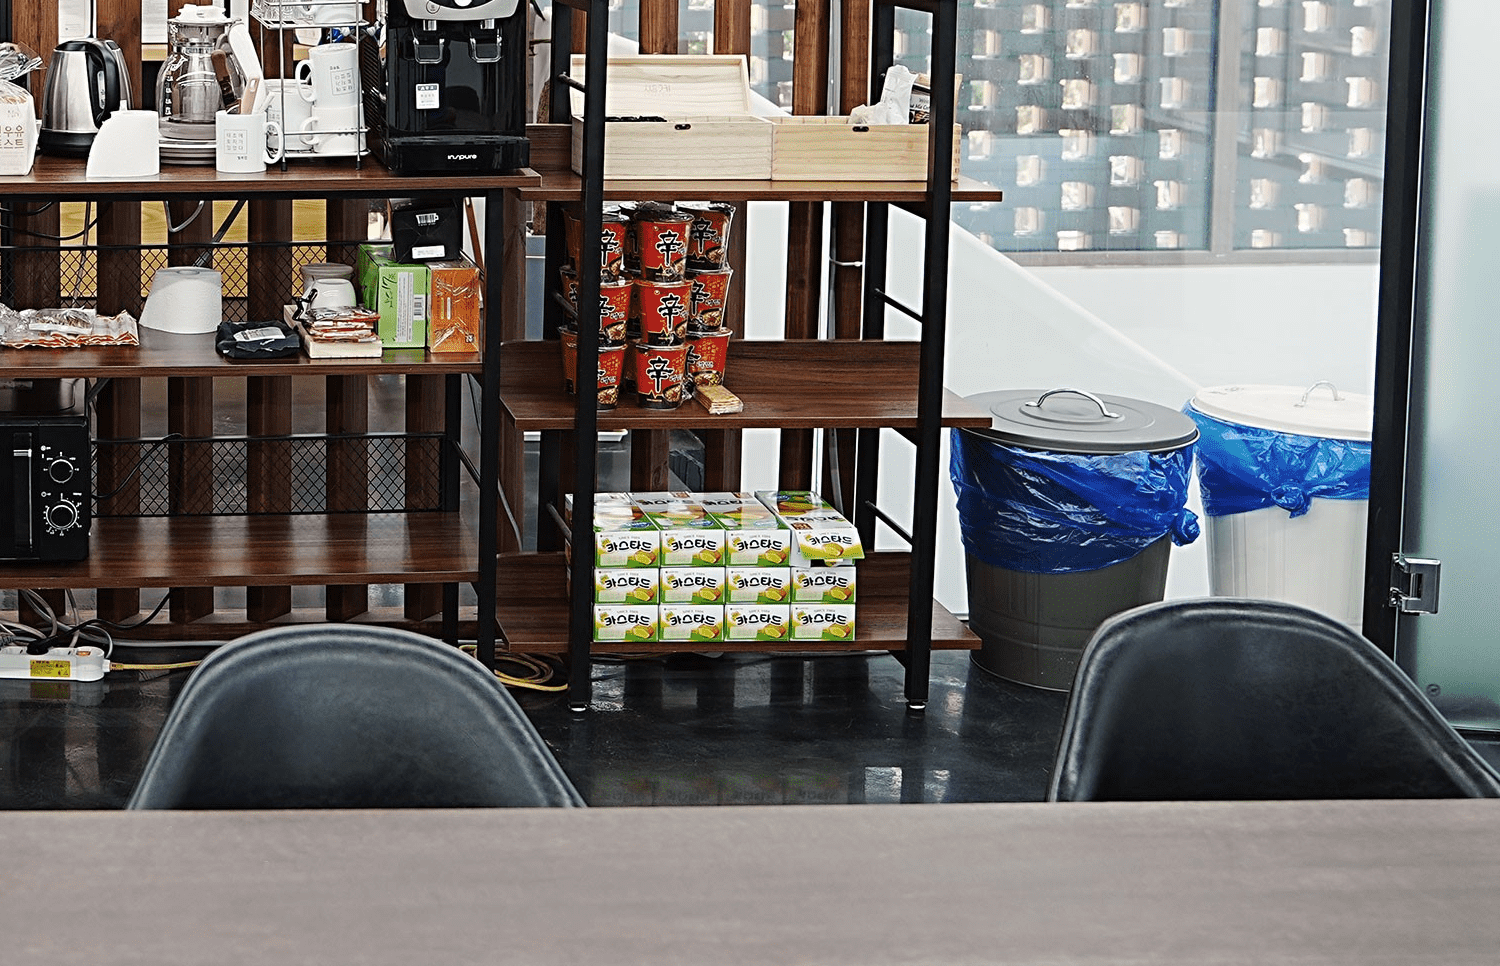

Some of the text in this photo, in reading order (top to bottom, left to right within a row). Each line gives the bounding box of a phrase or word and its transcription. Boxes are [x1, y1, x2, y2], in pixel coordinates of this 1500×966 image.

[3, 125, 24, 137] 우유
[655, 230, 684, 267] 辛
[658, 294, 685, 331] 辛
[646, 356, 674, 393] 辛
[606, 540, 653, 552] 카스타드
[671, 539, 717, 551] 카스타드
[737, 539, 783, 551] 카스타드
[809, 535, 852, 546] 카스타드
[605, 577, 651, 588] 카스타드
[671, 576, 717, 588] 카스타드
[737, 576, 783, 588] 카스타드
[802, 576, 848, 588] 카스타드
[604, 614, 650, 626] 카스타드
[670, 614, 716, 626] 카스타드
[736, 614, 782, 625] 카스타드
[801, 613, 847, 625] 카스타드
